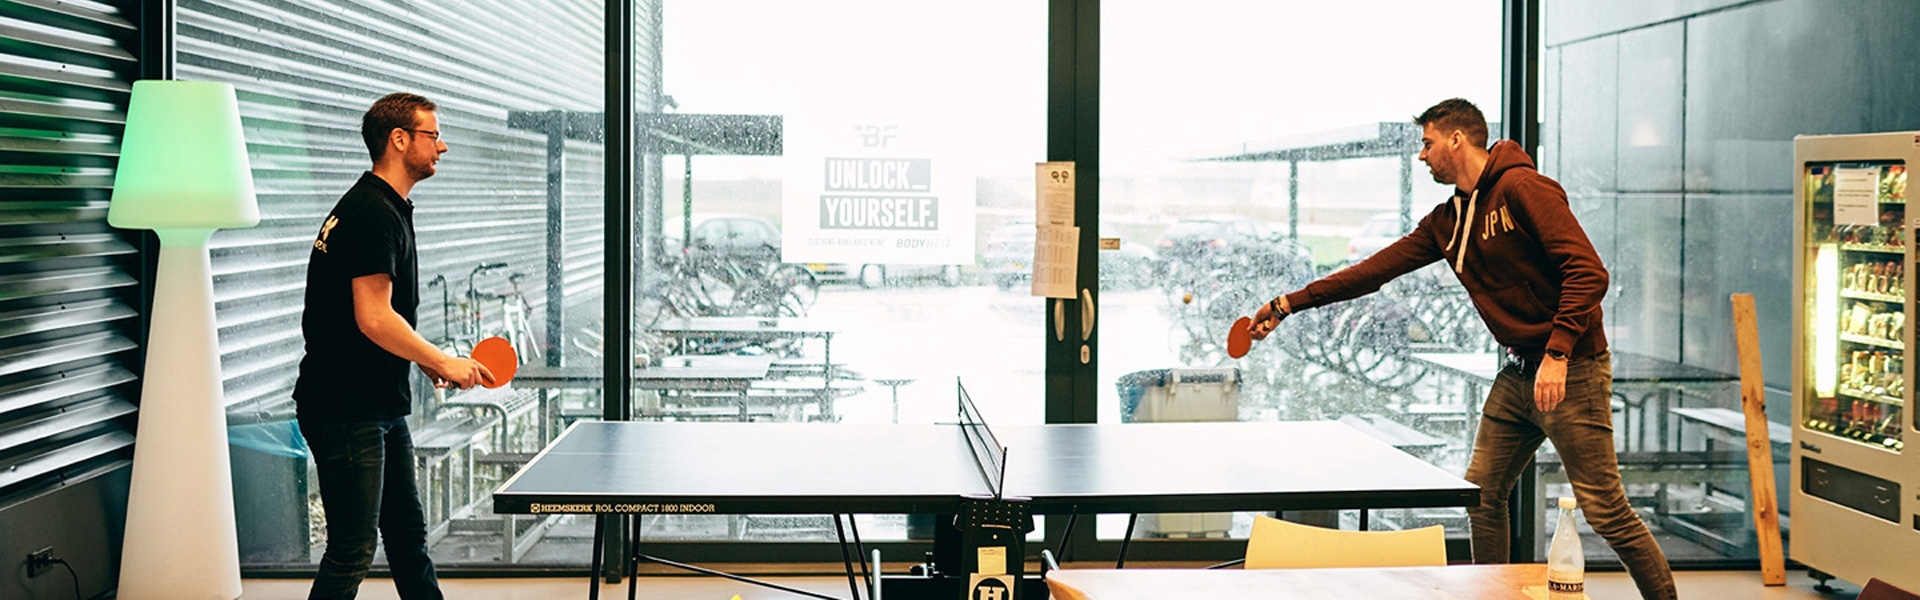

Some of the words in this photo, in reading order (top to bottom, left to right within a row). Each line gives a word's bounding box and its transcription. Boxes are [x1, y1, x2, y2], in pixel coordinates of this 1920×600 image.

[824, 197, 935, 228] YOURSELF.
[1481, 205, 1515, 241] JPN
[541, 503, 593, 513] HEEMSKERK
[595, 503, 614, 513] ROL
[614, 503, 660, 513] COMPACT
[679, 503, 716, 513] INDOOR
